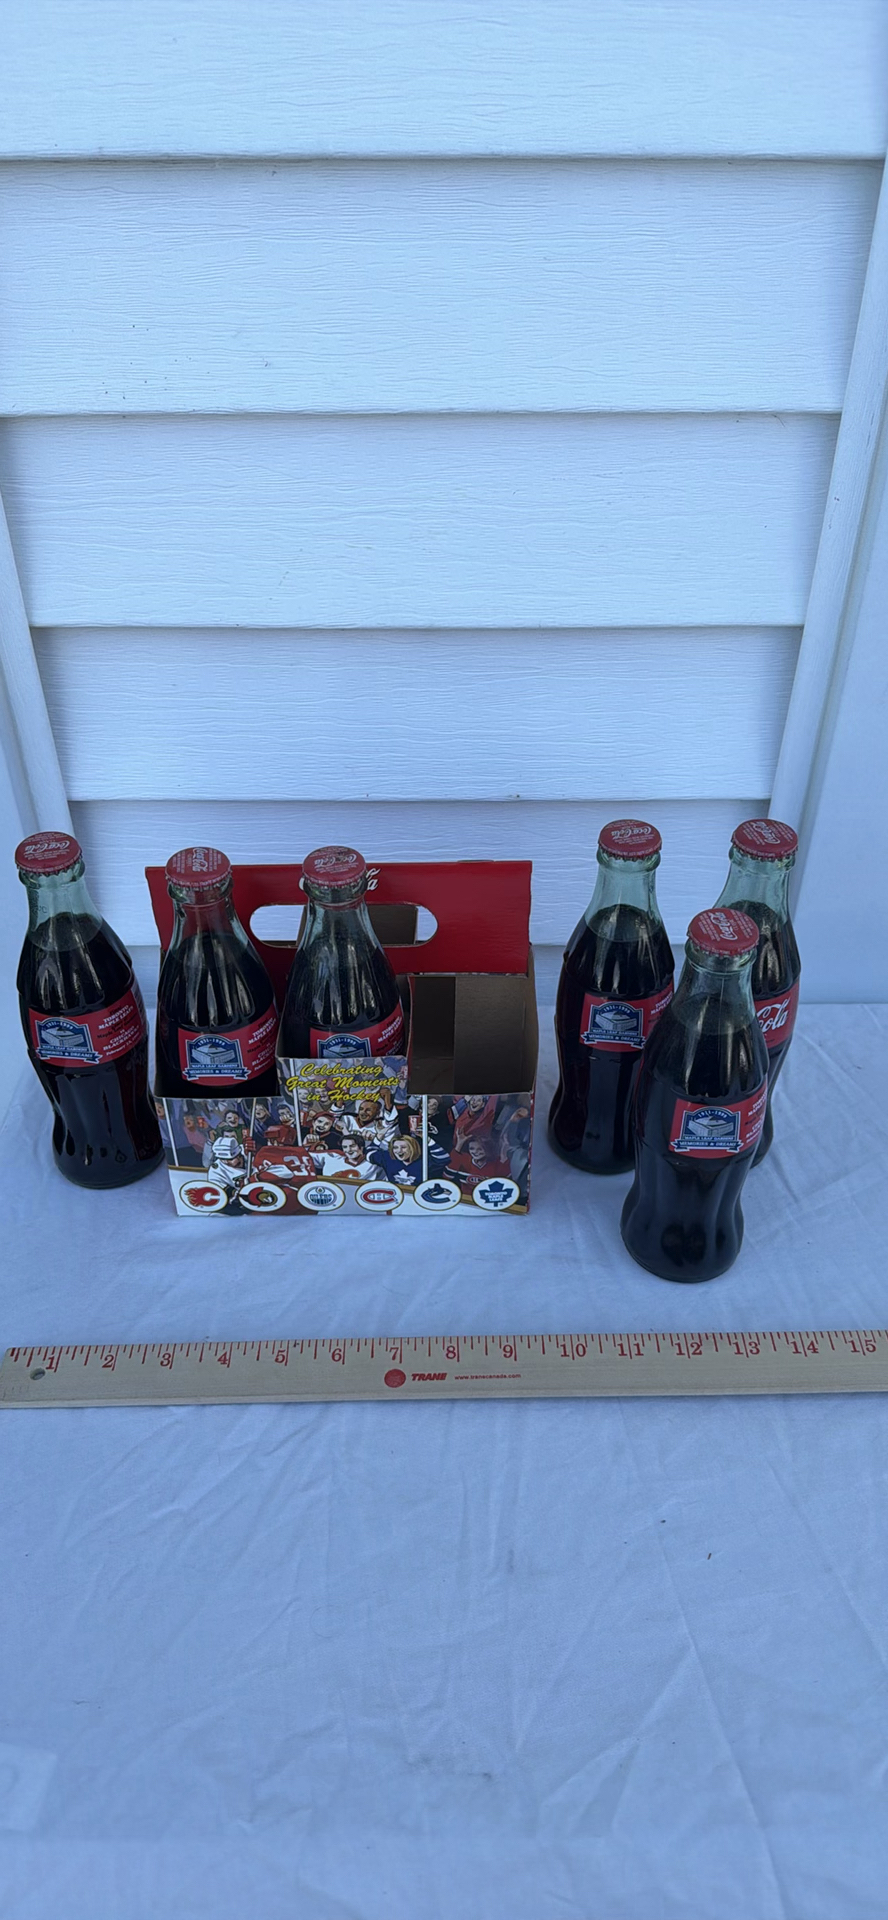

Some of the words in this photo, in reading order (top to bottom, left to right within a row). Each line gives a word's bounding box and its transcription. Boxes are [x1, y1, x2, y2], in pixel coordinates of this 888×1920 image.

[300, 1063, 383, 1077] Celebrating
[286, 1076, 327, 1091] Great
[332, 1076, 399, 1088] Moments
[307, 1092, 321, 1101] in
[327, 1089, 380, 1102] Hockey
[46, 1356, 55, 1370] 1
[102, 1354, 115, 1369] 2
[160, 1352, 171, 1367] 3
[217, 1351, 229, 1365] 4
[274, 1349, 286, 1364] 5
[331, 1347, 342, 1362] 6
[389, 1346, 399, 1361] 7
[445, 1345, 457, 1360] 8
[502, 1344, 513, 1359] 9
[560, 1343, 587, 1358] 10
[617, 1342, 644, 1357] 11
[675, 1341, 703, 1356] 12
[732, 1340, 760, 1355] 13
[790, 1340, 819, 1354] 14
[848, 1339, 877, 1353] 15
[410, 1372, 448, 1382] TRANE
